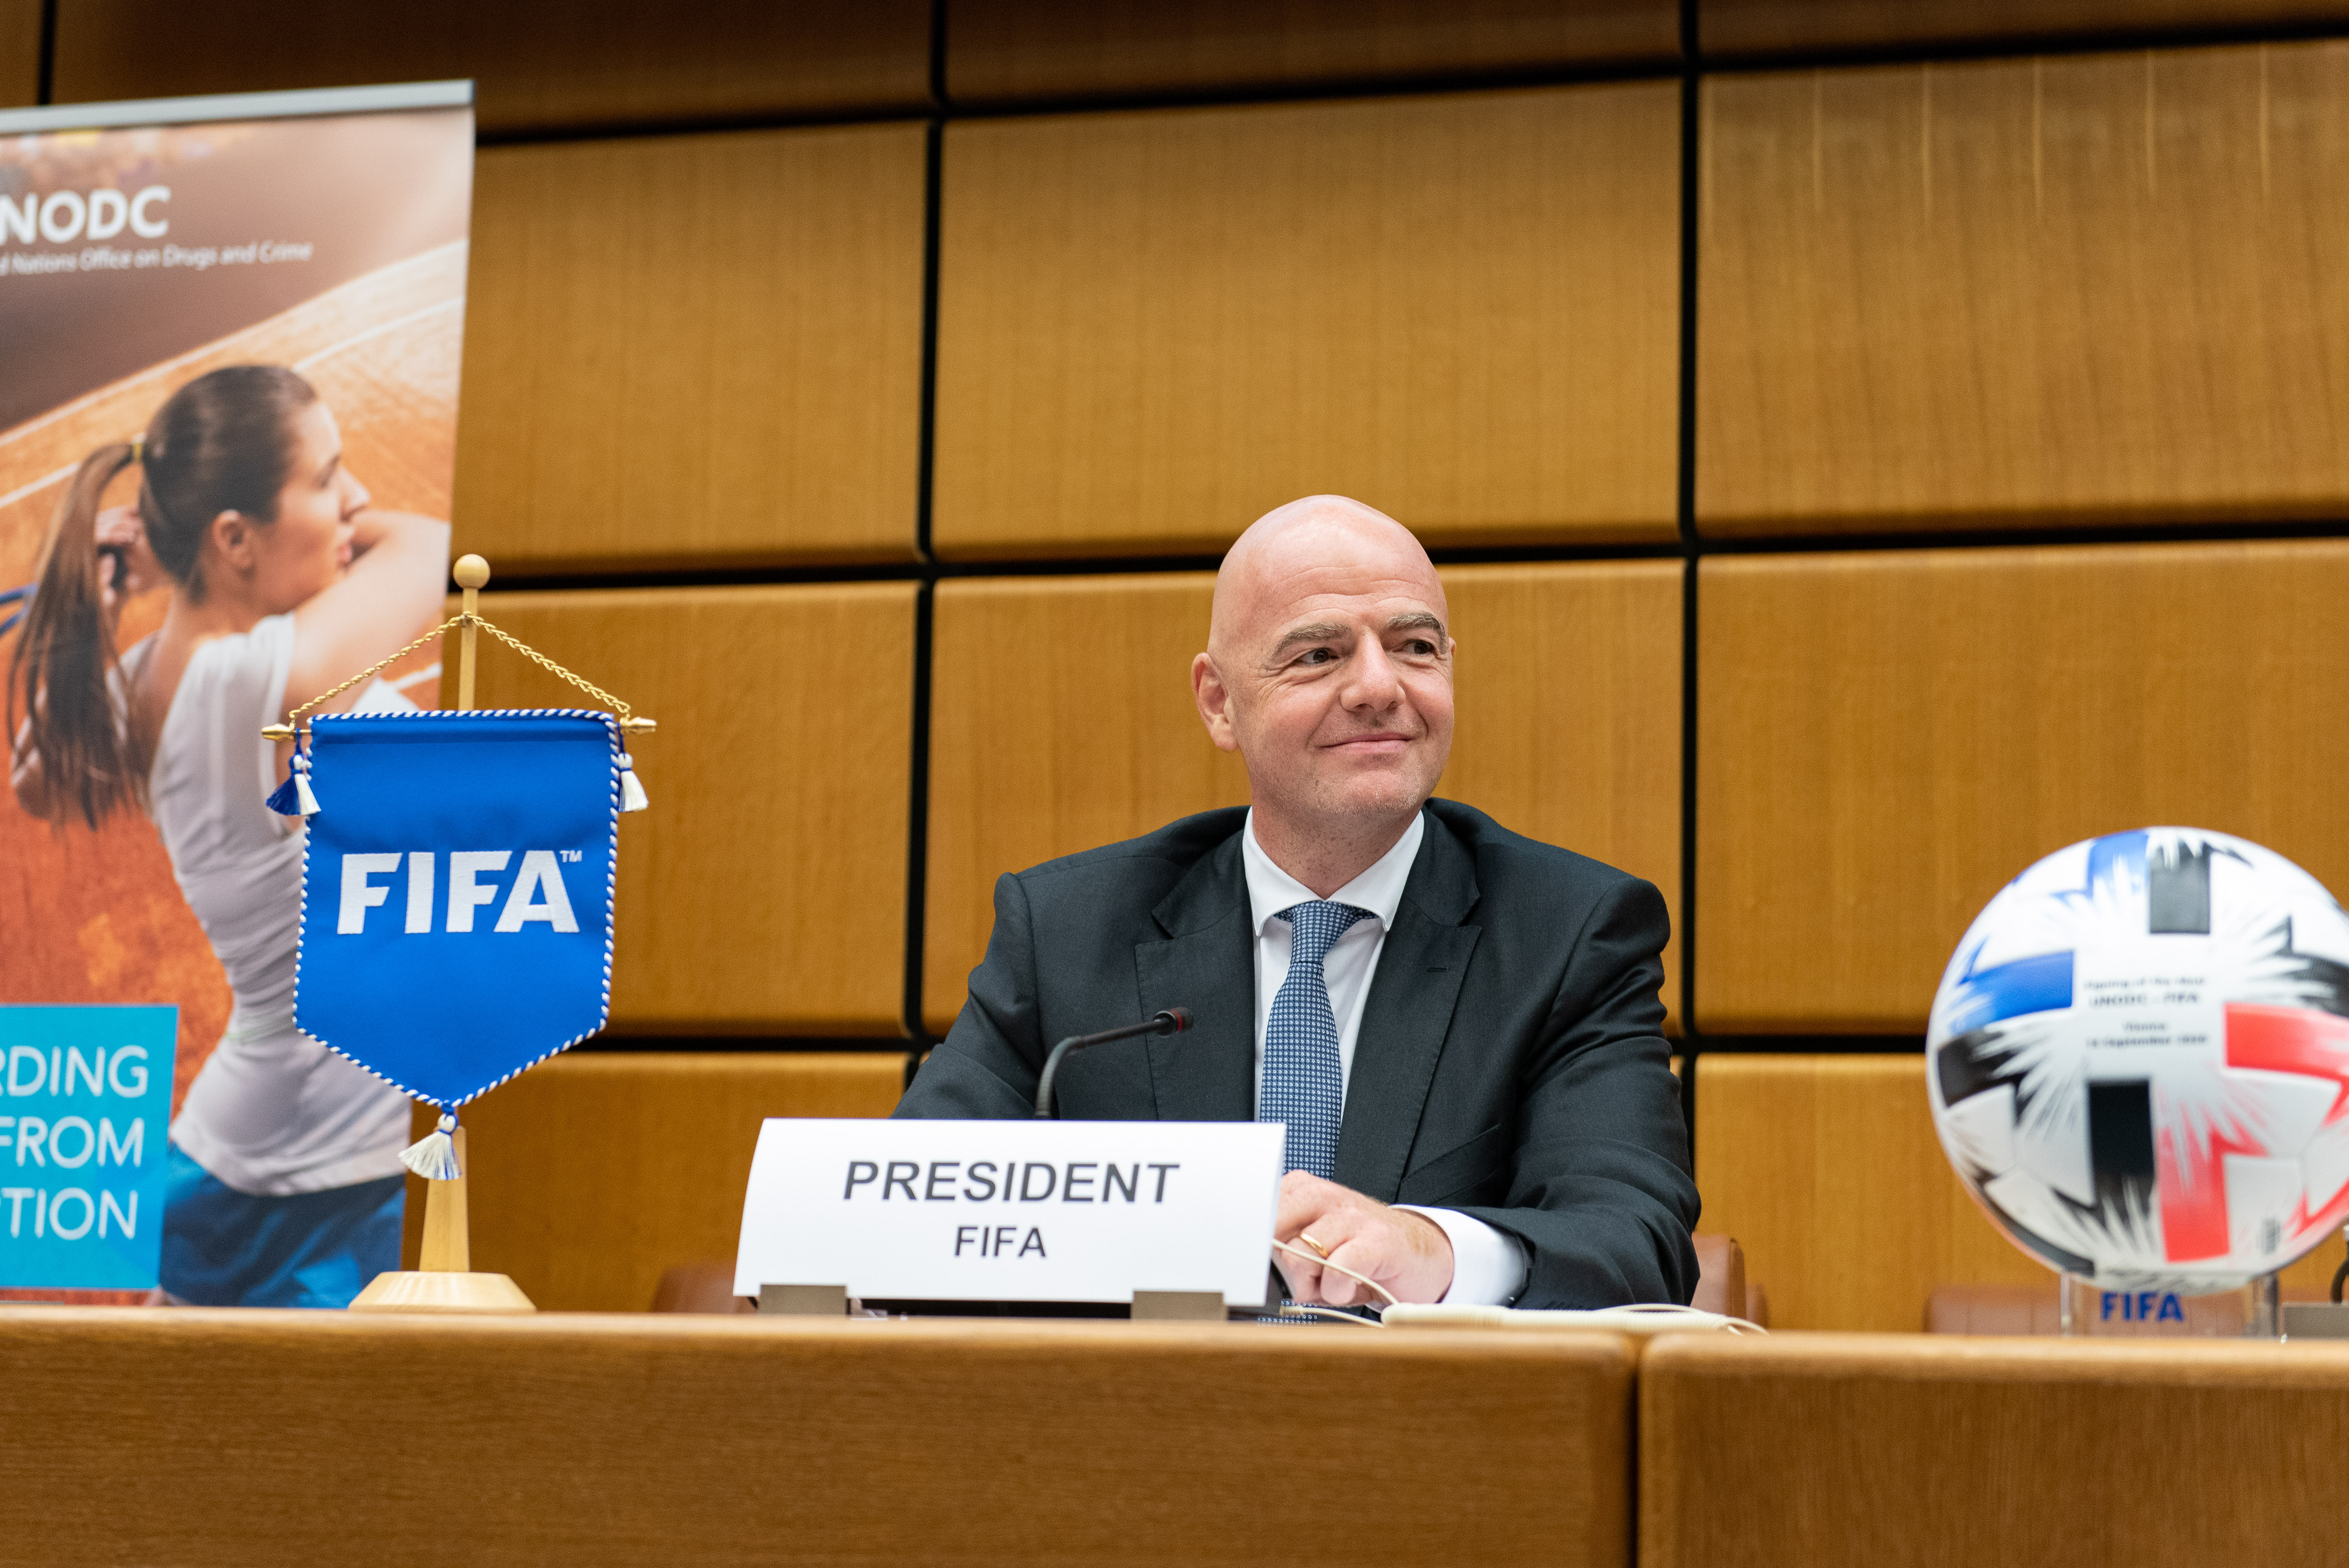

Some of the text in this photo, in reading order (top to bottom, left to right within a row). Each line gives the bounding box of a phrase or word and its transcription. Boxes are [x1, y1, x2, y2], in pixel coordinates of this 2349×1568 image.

[13, 252, 76, 274] Nations
[80, 246, 132, 271] Office
[135, 249, 159, 268] on
[163, 243, 217, 271] Drugs
[220, 242, 257, 265] and
[258, 239, 313, 264] Crime
[843, 1160, 1181, 1203] PRESIDENT
[954, 1226, 1047, 1258] FIFA
[2100, 1291, 2184, 1322] FIFA
